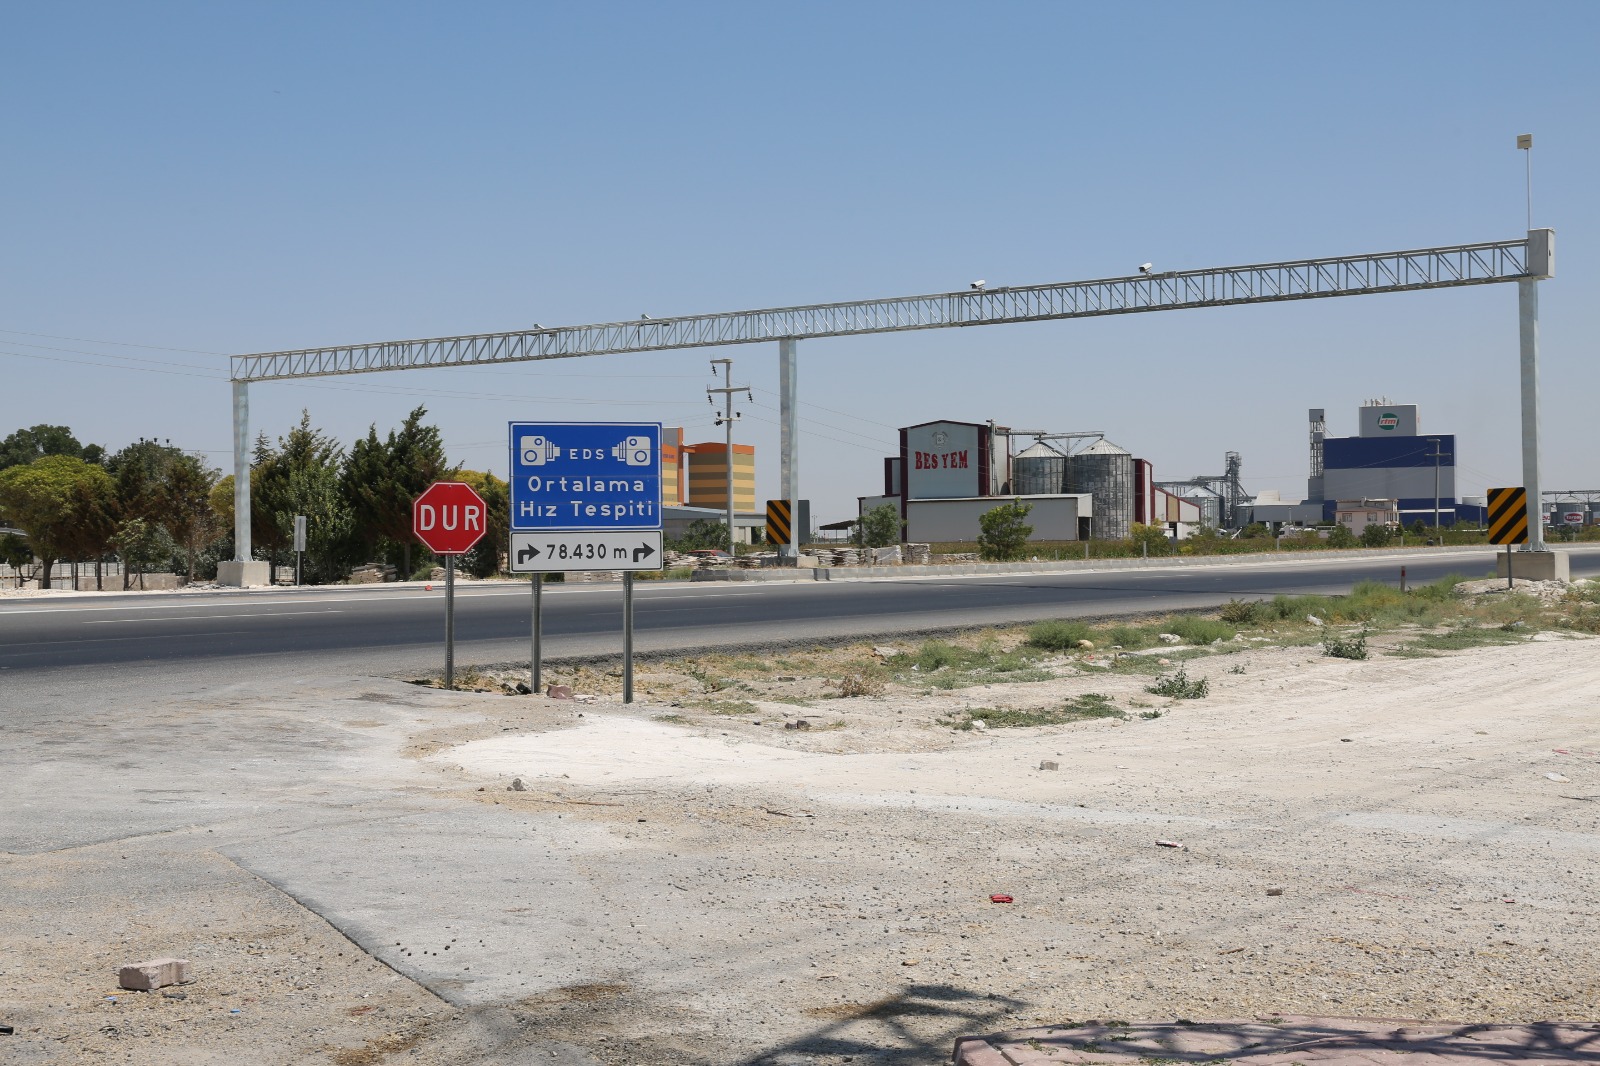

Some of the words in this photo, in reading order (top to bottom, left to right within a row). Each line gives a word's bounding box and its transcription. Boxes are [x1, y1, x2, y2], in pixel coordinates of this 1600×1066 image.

[569, 448, 605, 460] EDS
[915, 451, 939, 470] BES
[941, 450, 968, 469] YEM
[527, 475, 644, 492] Ortalama
[420, 504, 480, 531] DUR
[520, 500, 557, 517] Hız
[570, 500, 652, 520] Tespiti
[546, 543, 607, 560] 78.430
[613, 546, 628, 559] m
